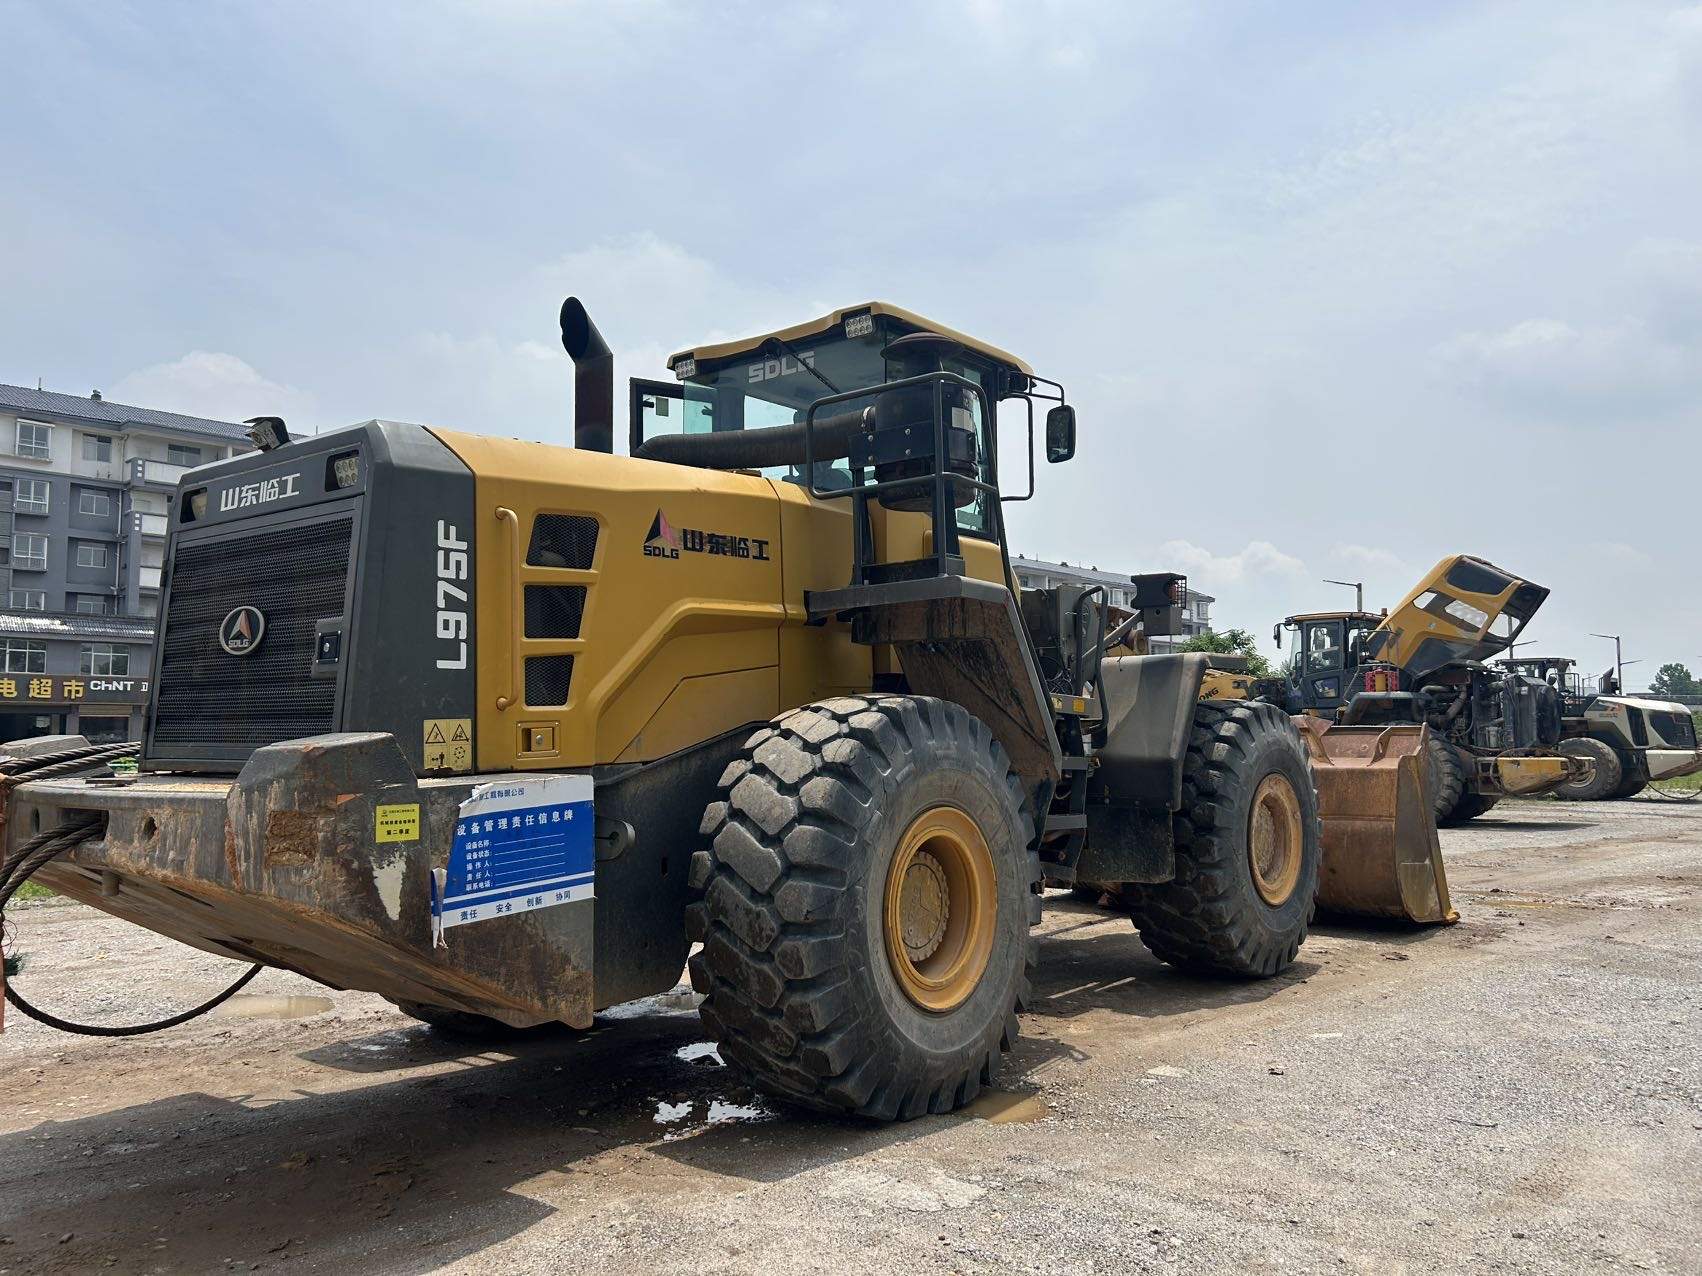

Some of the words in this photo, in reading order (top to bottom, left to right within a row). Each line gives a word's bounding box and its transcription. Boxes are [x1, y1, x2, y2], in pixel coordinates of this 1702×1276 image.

[748, 351, 815, 383] SDLG
[220, 473, 300, 511] 山东临工
[643, 545, 679, 560] SDLG
[682, 528, 770, 561] 山东临工
[436, 519, 468, 670] L975F
[228, 638, 250, 648] SDLG
[457, 809, 574, 836] 设备管理责任信息牌
[460, 910, 478, 921] 责任
[496, 902, 512, 914] 安全
[527, 896, 543, 907] 创新
[555, 890, 571, 901] 协同
